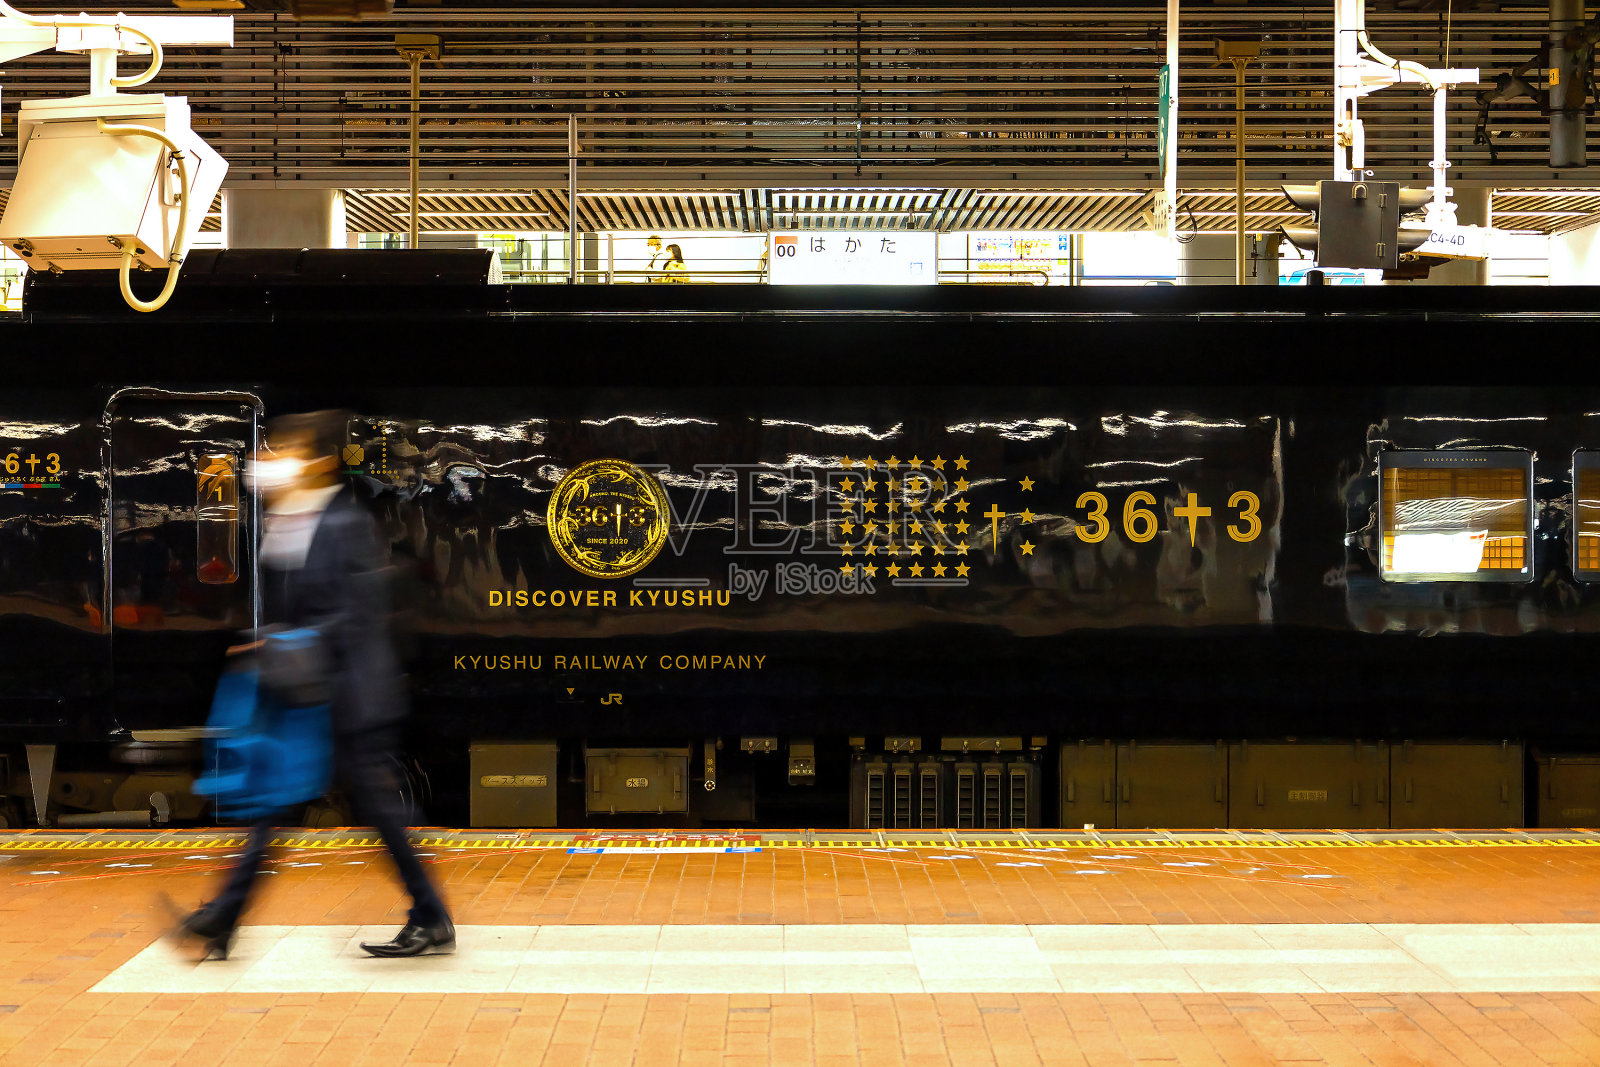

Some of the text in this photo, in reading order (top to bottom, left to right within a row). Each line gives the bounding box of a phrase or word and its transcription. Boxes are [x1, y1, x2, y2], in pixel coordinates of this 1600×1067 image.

[1425, 232, 1465, 246] C4-4D
[777, 245, 796, 257] 00
[214, 486, 222, 502] 1
[586, 537, 629, 545] SINCE 2020
[489, 590, 731, 607] DISCOVER KYUSHU
[453, 655, 767, 670] KYUSHU RAILWAY COMPANY
[600, 693, 623, 705] JR
